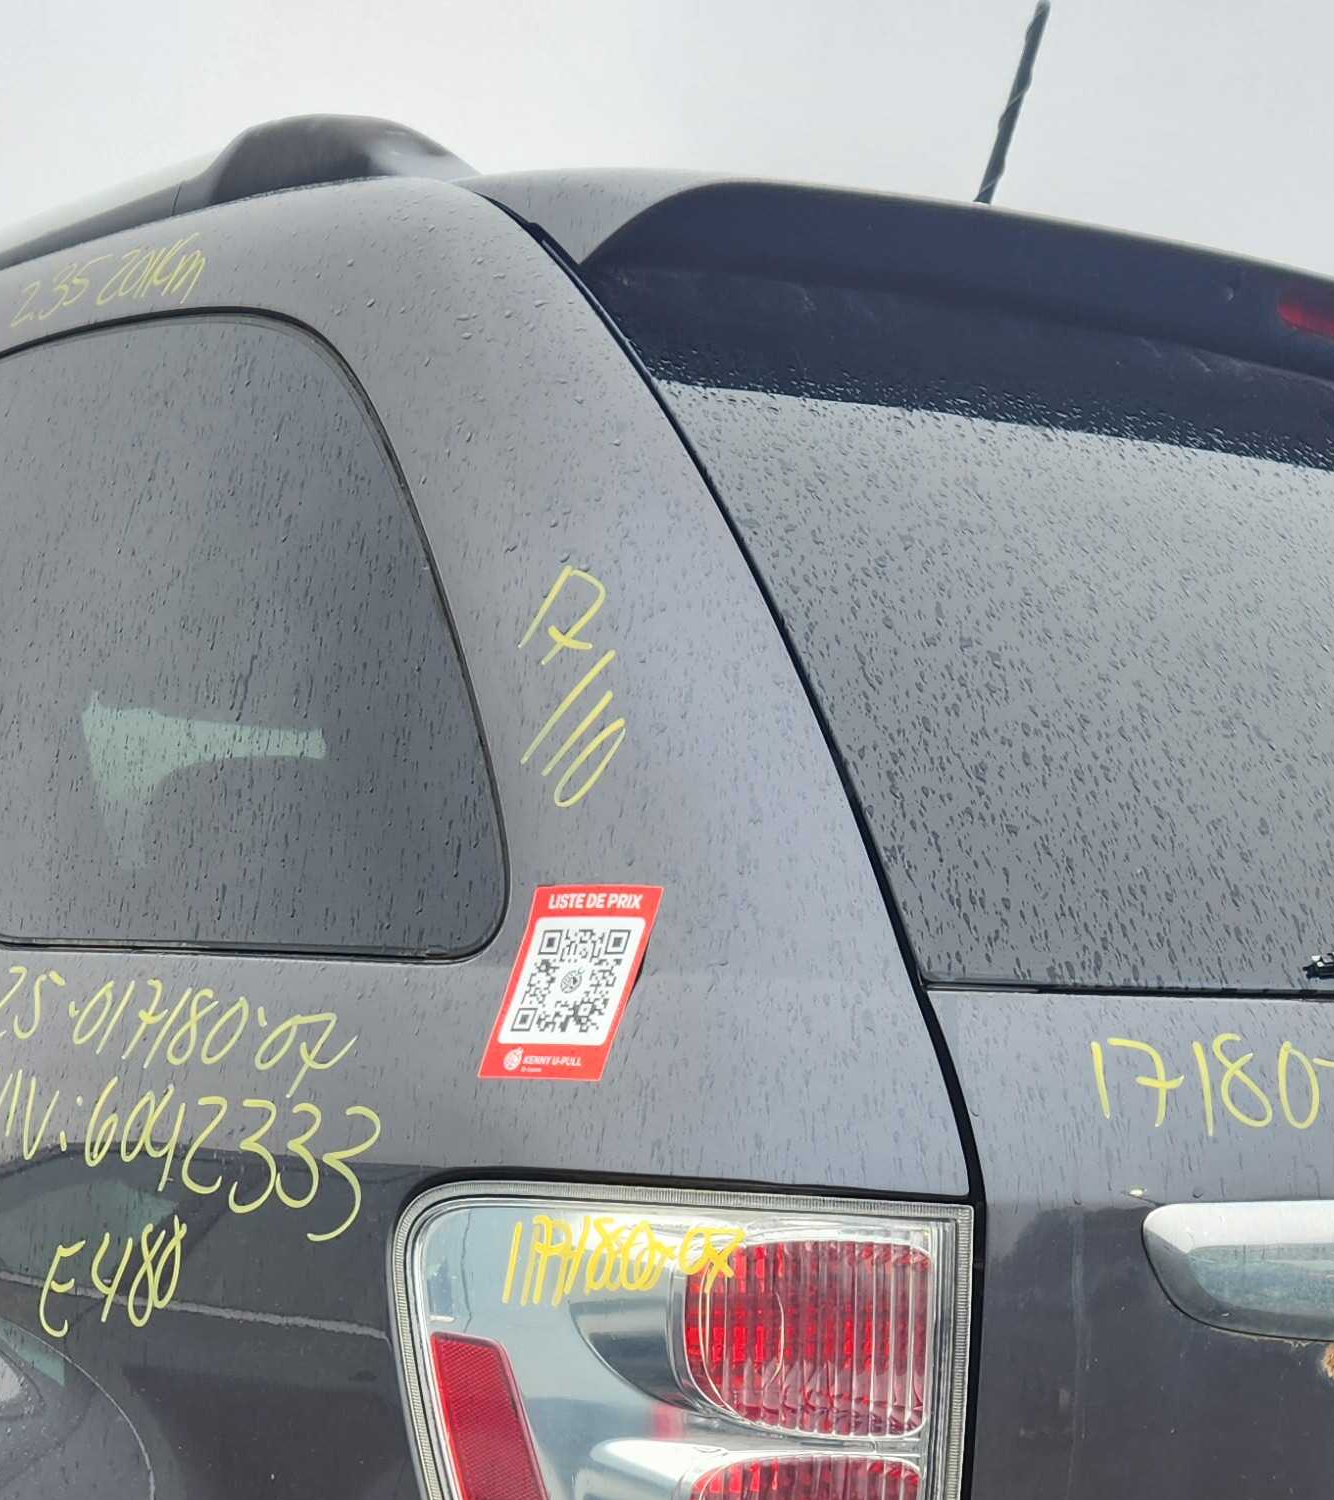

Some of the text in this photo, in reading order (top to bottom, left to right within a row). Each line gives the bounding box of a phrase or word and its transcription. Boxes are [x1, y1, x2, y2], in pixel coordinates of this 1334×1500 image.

[548, 893, 643, 910] LISTE DE PRIX
[522, 1055, 552, 1065] KENNY
[39, 1215, 188, 1338] E480
